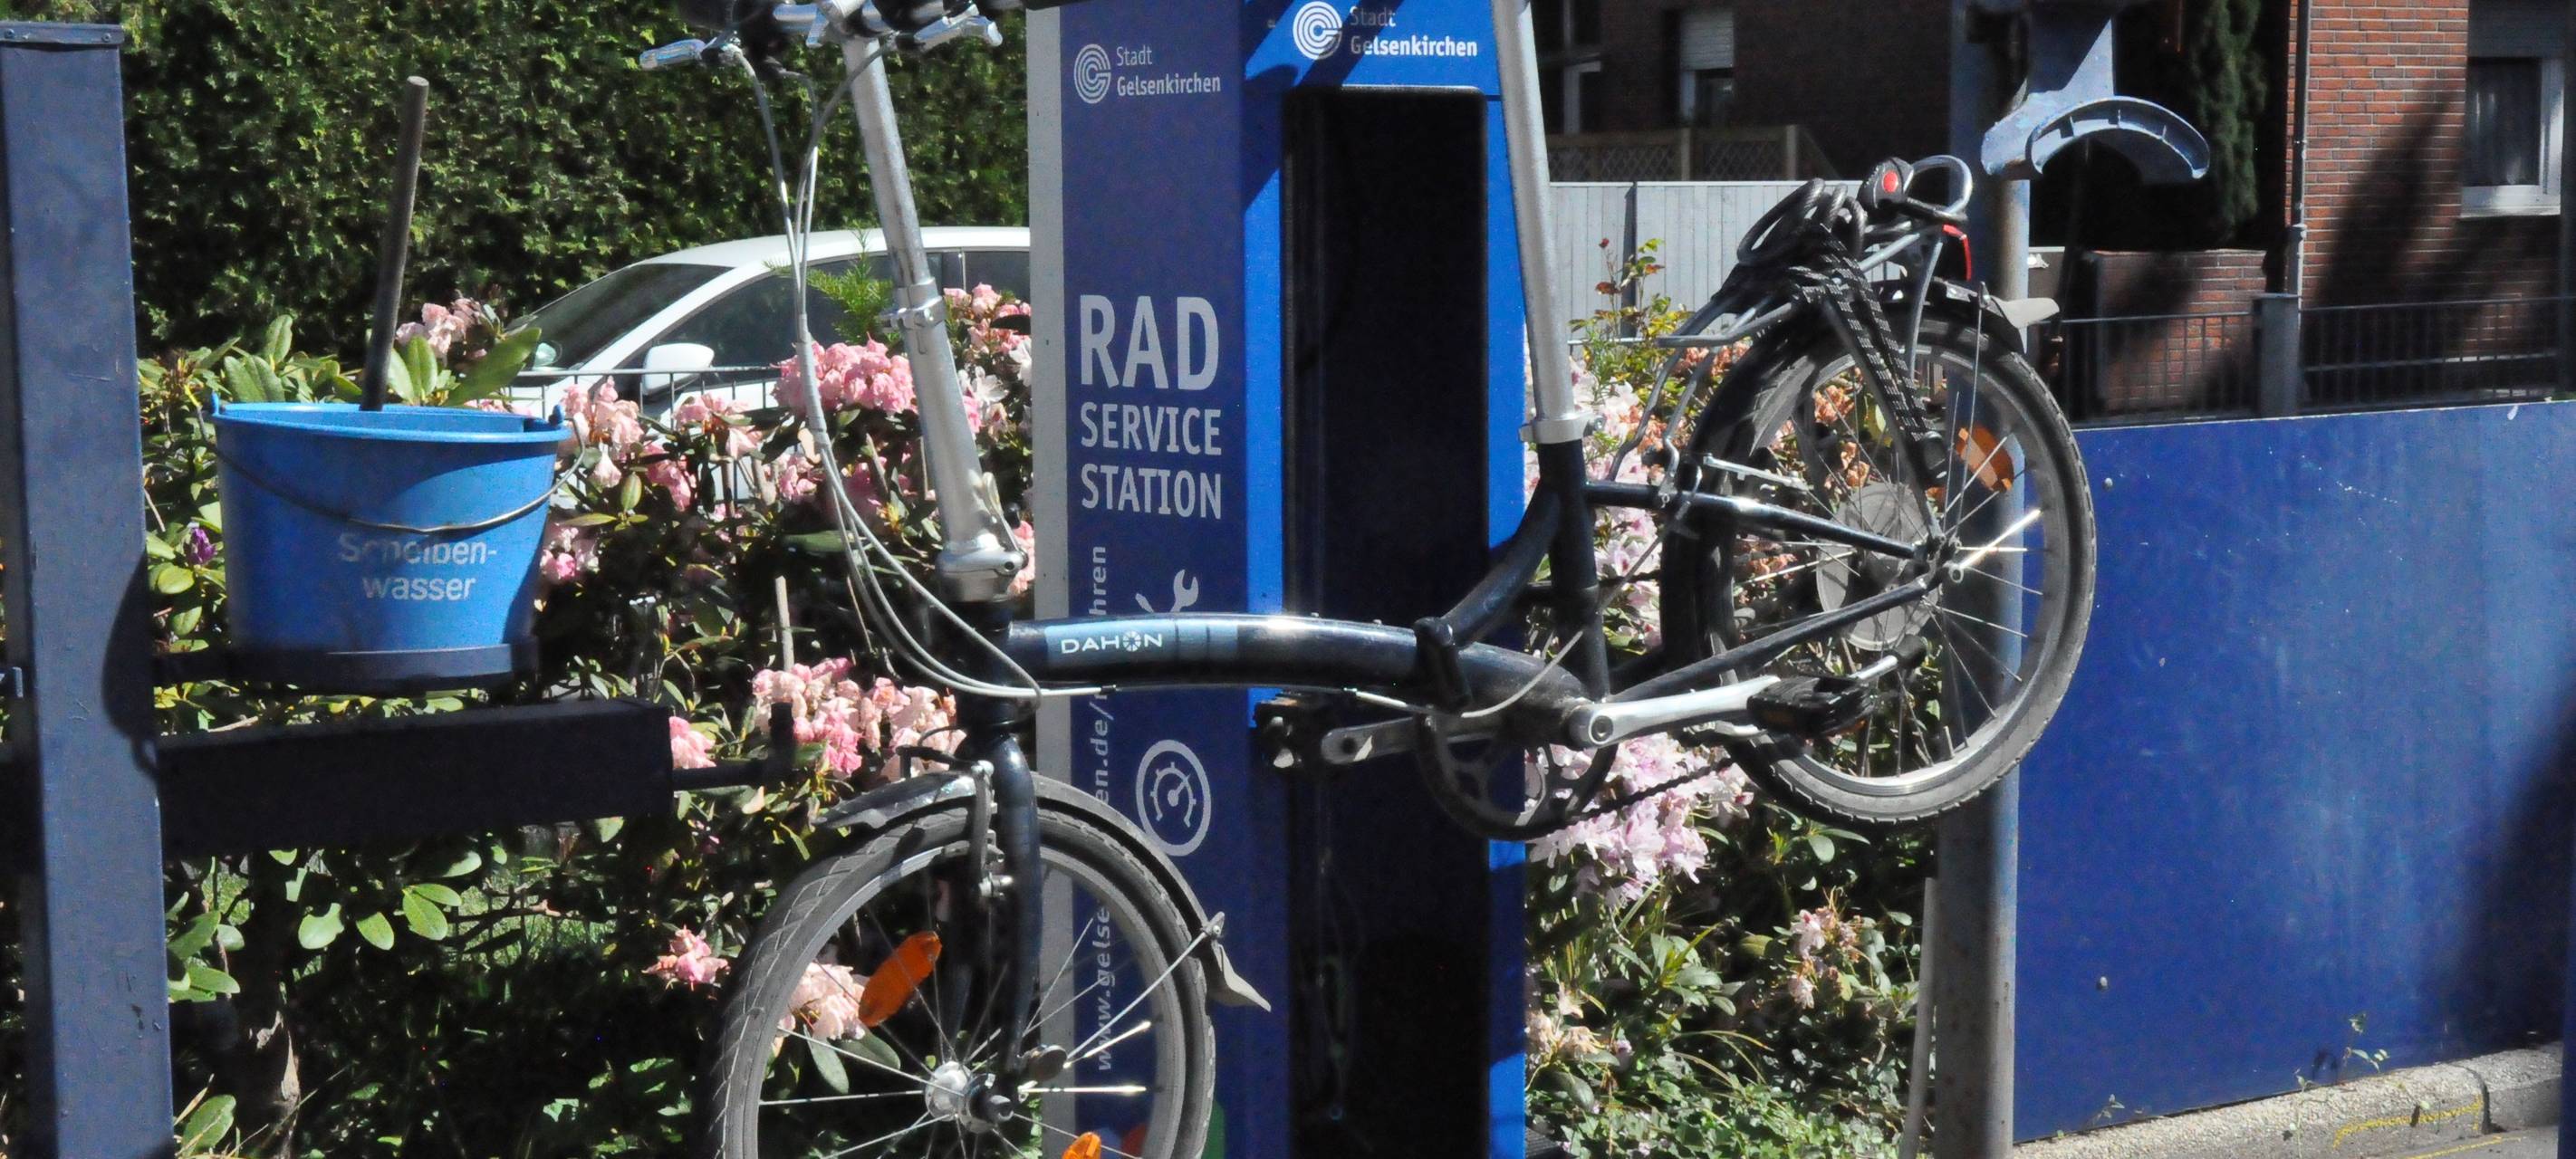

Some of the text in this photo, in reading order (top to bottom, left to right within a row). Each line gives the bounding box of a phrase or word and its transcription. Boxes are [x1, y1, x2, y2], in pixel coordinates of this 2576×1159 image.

[1350, 6, 1396, 27] Stadt
[1117, 45, 1153, 66] Stadt
[1350, 34, 1477, 57] Gelsenkirchen
[1117, 72, 1221, 96] Gelsenkirchen
[1081, 294, 1219, 390] RAD
[1081, 401, 1222, 455] SERVICE
[1081, 464, 1222, 520] STATION
[364, 577, 476, 601] wasser
[1061, 631, 1163, 654] DAHON
